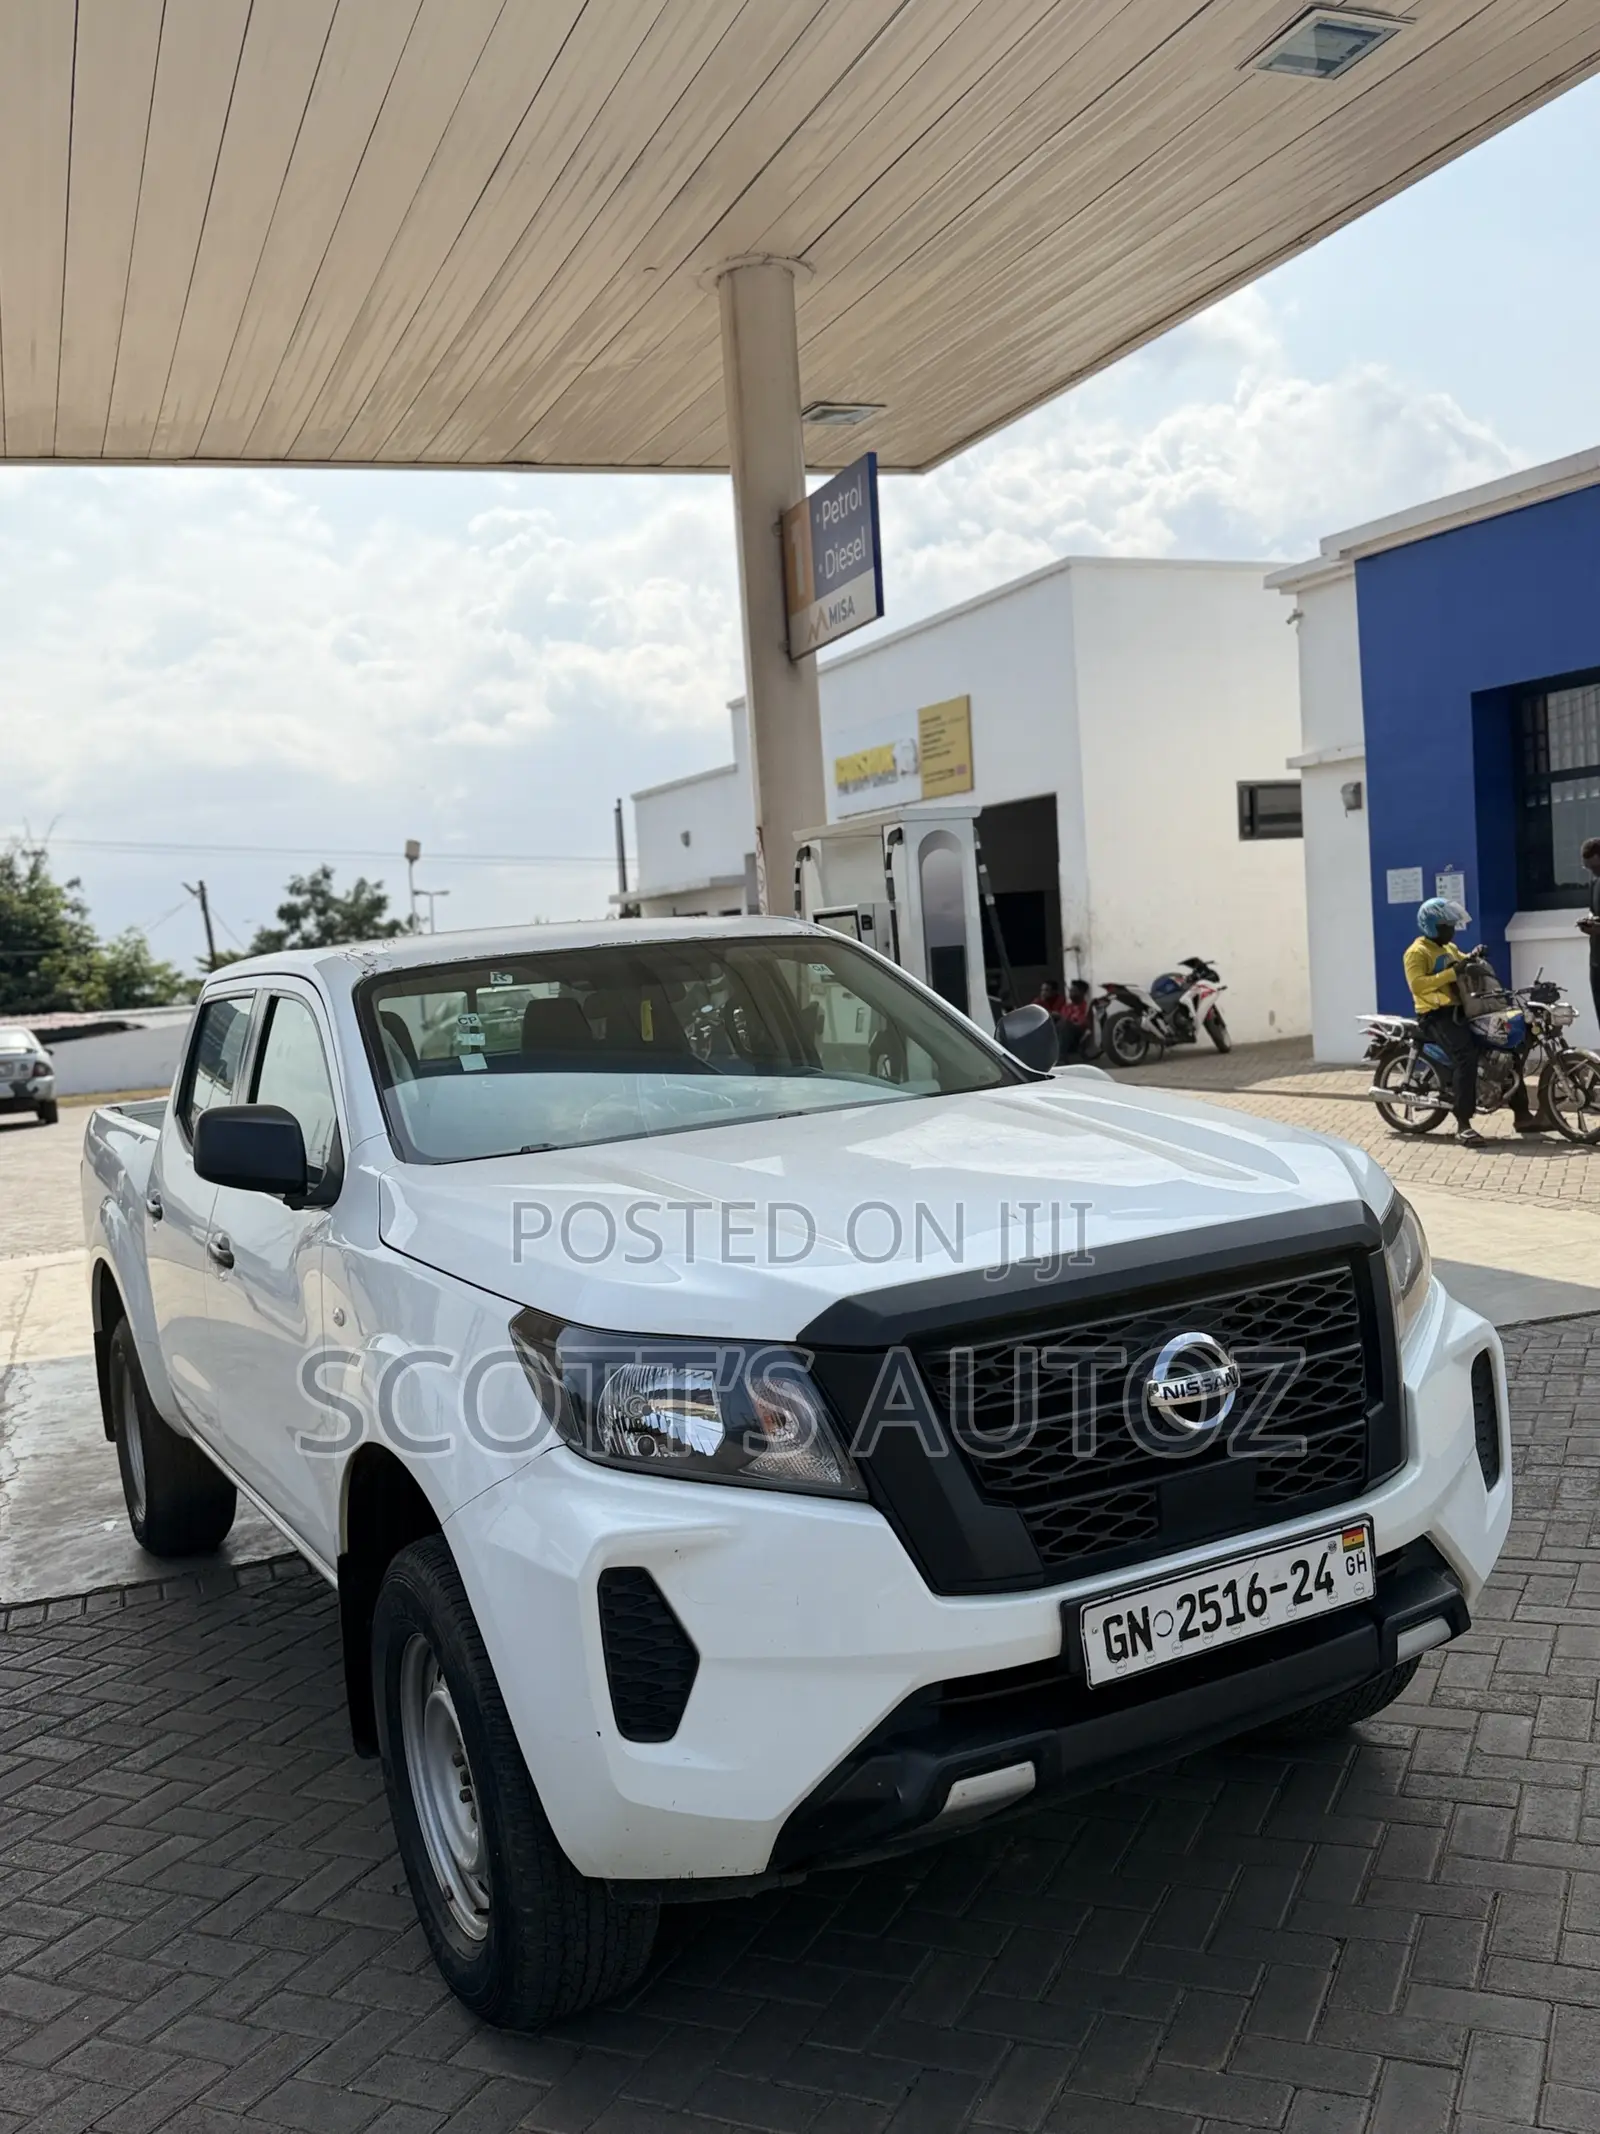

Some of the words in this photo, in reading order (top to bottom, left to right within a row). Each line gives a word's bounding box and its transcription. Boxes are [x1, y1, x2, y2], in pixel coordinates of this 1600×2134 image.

[822, 474, 863, 530] Petrol
[825, 526, 866, 580] Diesel
[828, 595, 856, 630] MISA
[1162, 1367, 1238, 1401] NISSAN
[1345, 1549, 1367, 1577] GH
[1102, 1605, 1154, 1664] GN
[1176, 1552, 1335, 1642] 2516-24
